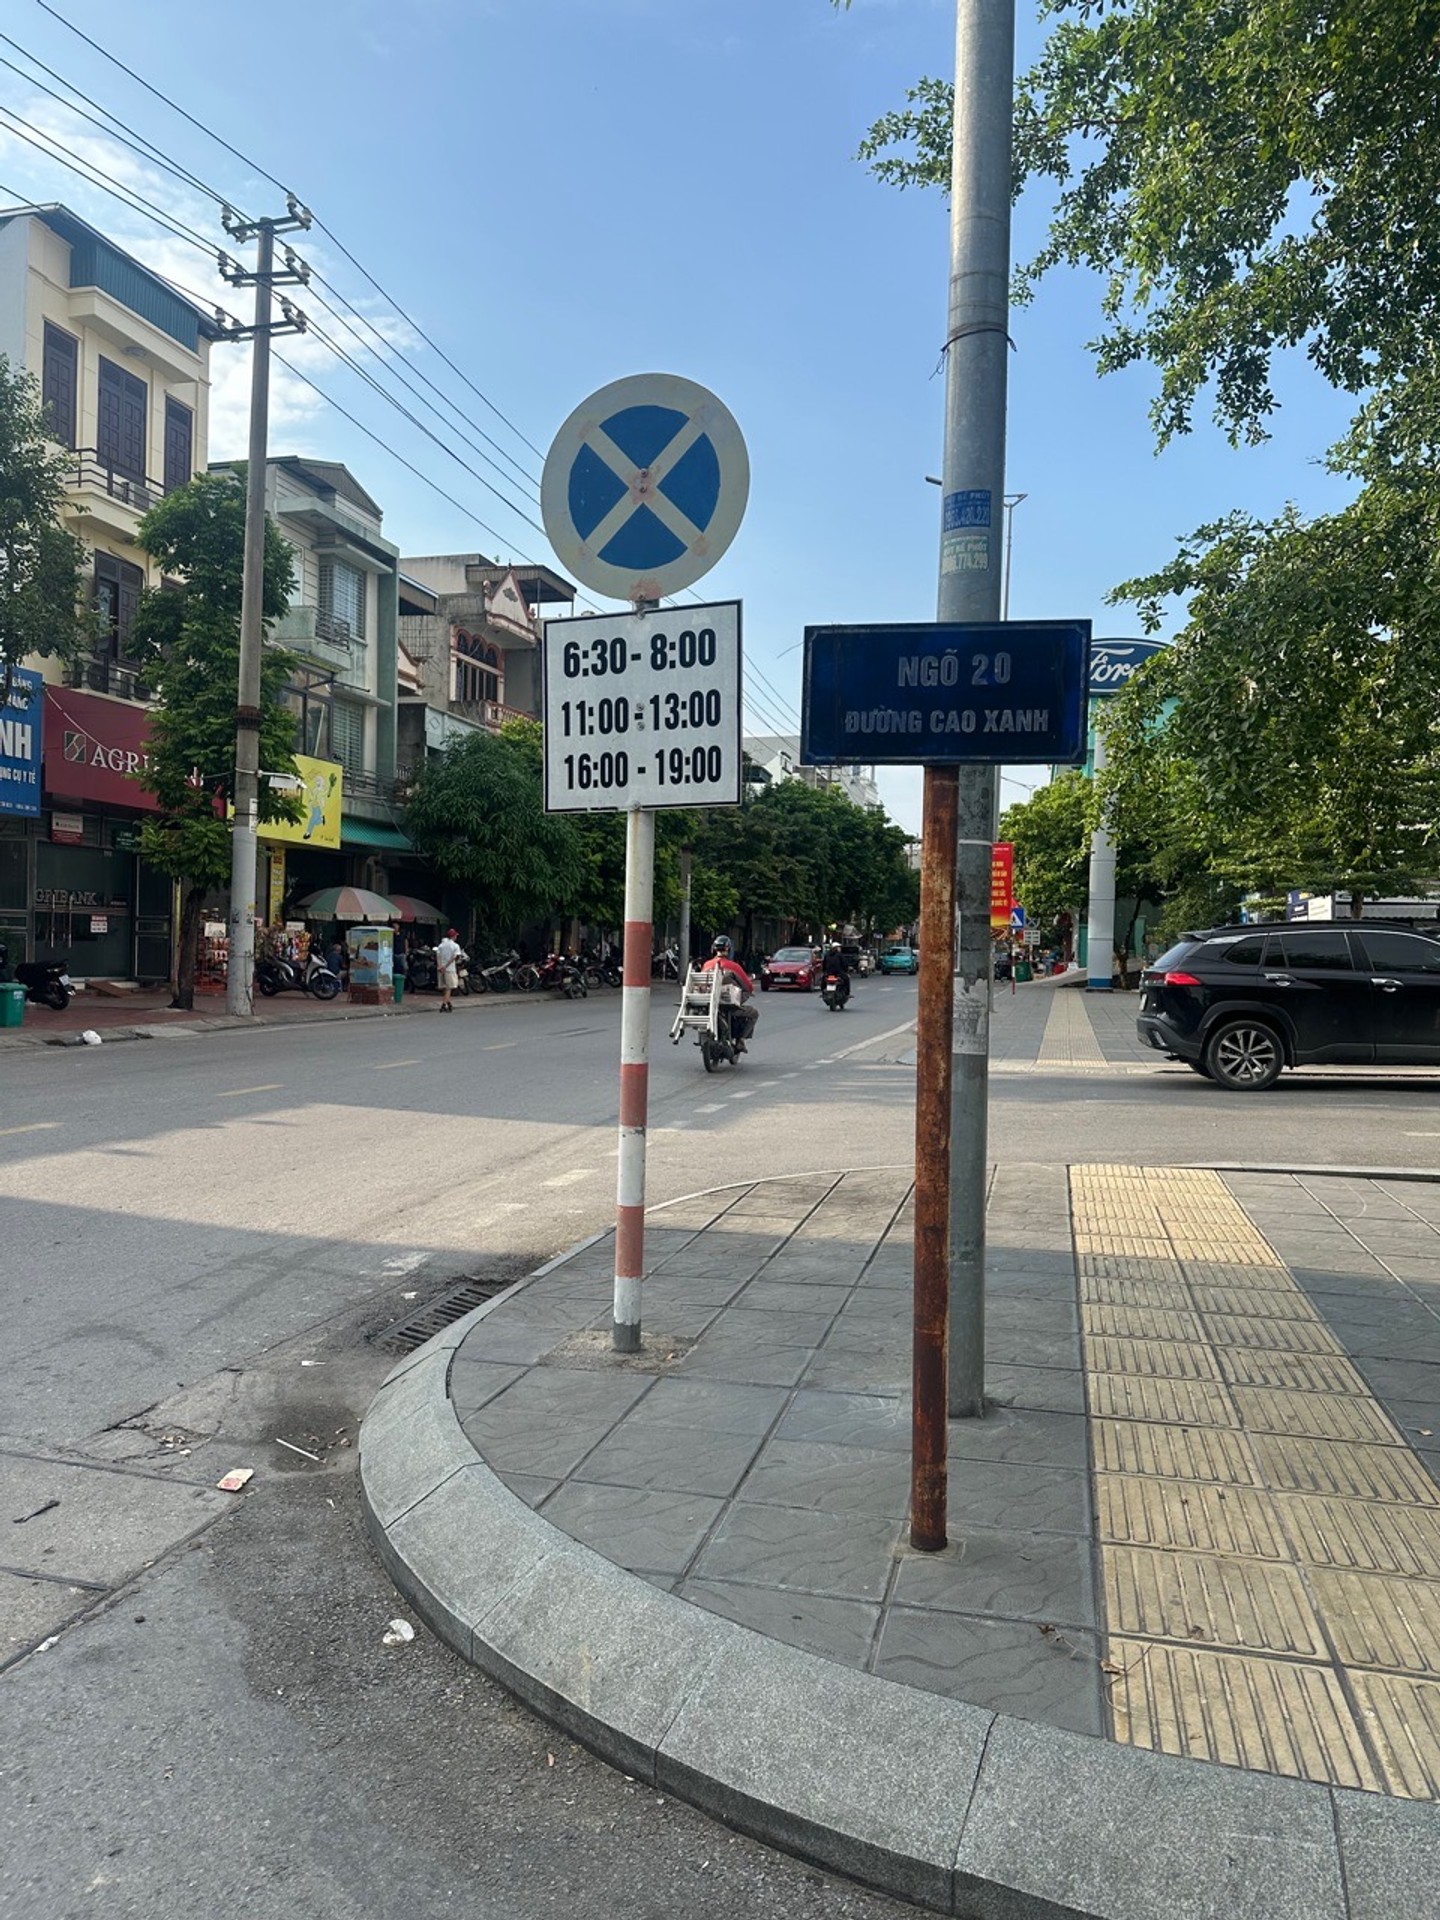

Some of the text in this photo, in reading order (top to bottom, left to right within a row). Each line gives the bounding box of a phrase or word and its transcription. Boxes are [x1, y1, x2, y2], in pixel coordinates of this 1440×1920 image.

[563, 637, 627, 678] 6:30
[650, 628, 716, 671] 8:00
[897, 648, 959, 687] NGÕ
[561, 697, 629, 737] 11:00
[649, 689, 721, 731] 13:00
[845, 703, 1049, 733] ĐƯỜNG CAO XANH
[564, 751, 628, 790] 16:00
[655, 745, 722, 786] 19:00
